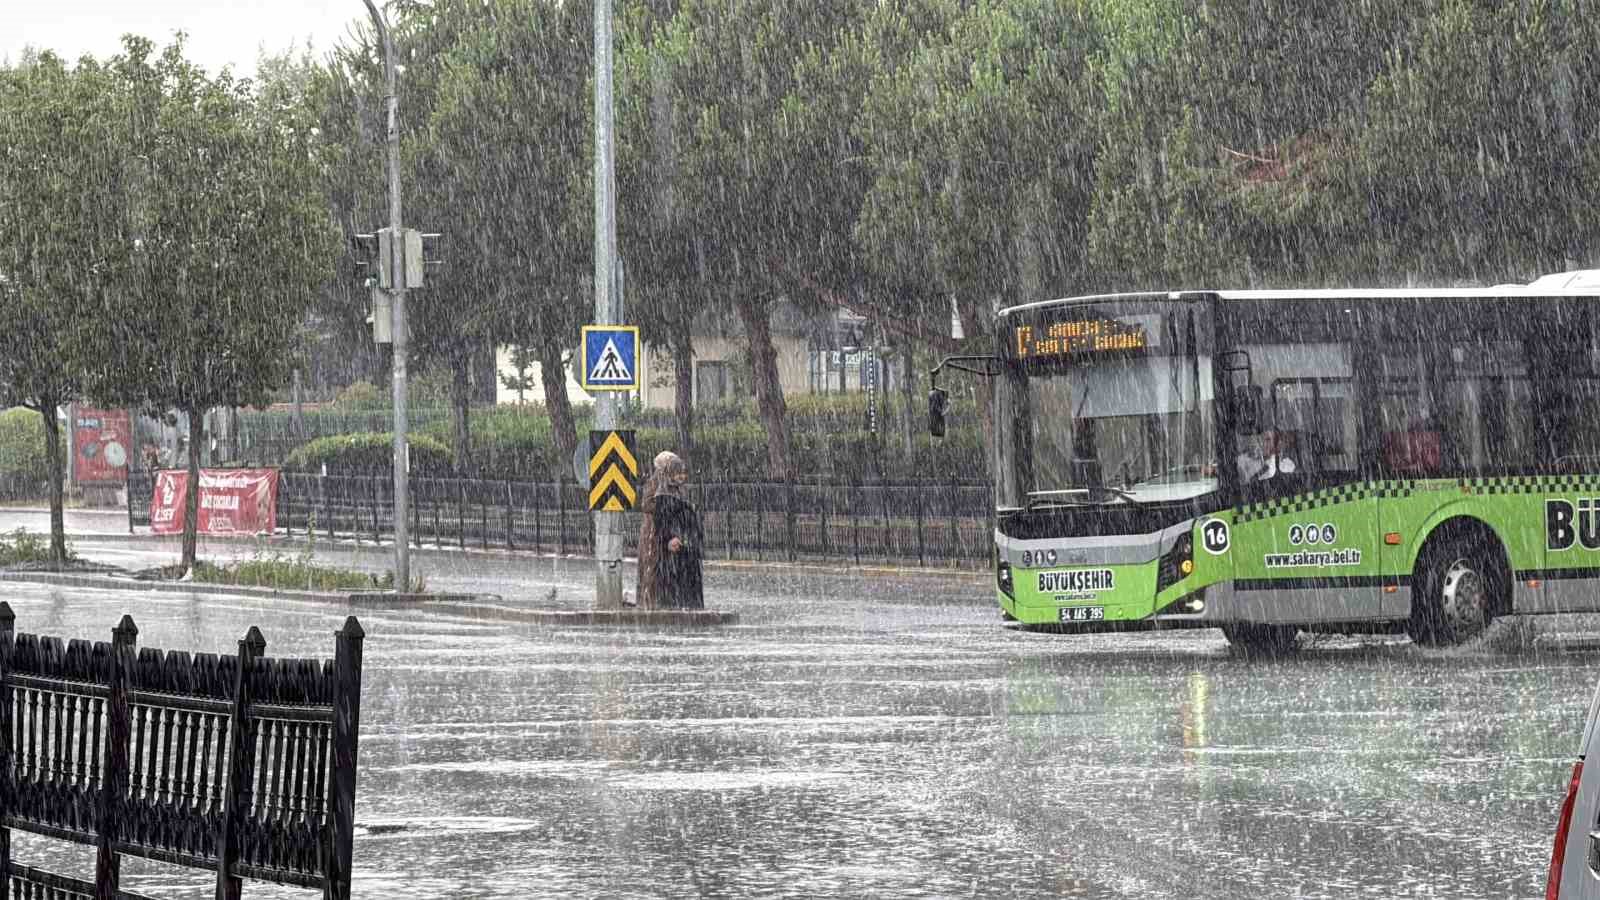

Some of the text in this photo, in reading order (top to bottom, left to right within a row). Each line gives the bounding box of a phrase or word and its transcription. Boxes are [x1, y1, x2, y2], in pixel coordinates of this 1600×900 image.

[1206, 527, 1226, 546] 16
[1266, 549, 1360, 567] www.sakarya.bel.tr
[1038, 569, 1113, 592] BÜYÜKŞEHİR
[1061, 608, 1071, 620] 54
[1089, 607, 1104, 619] 395
